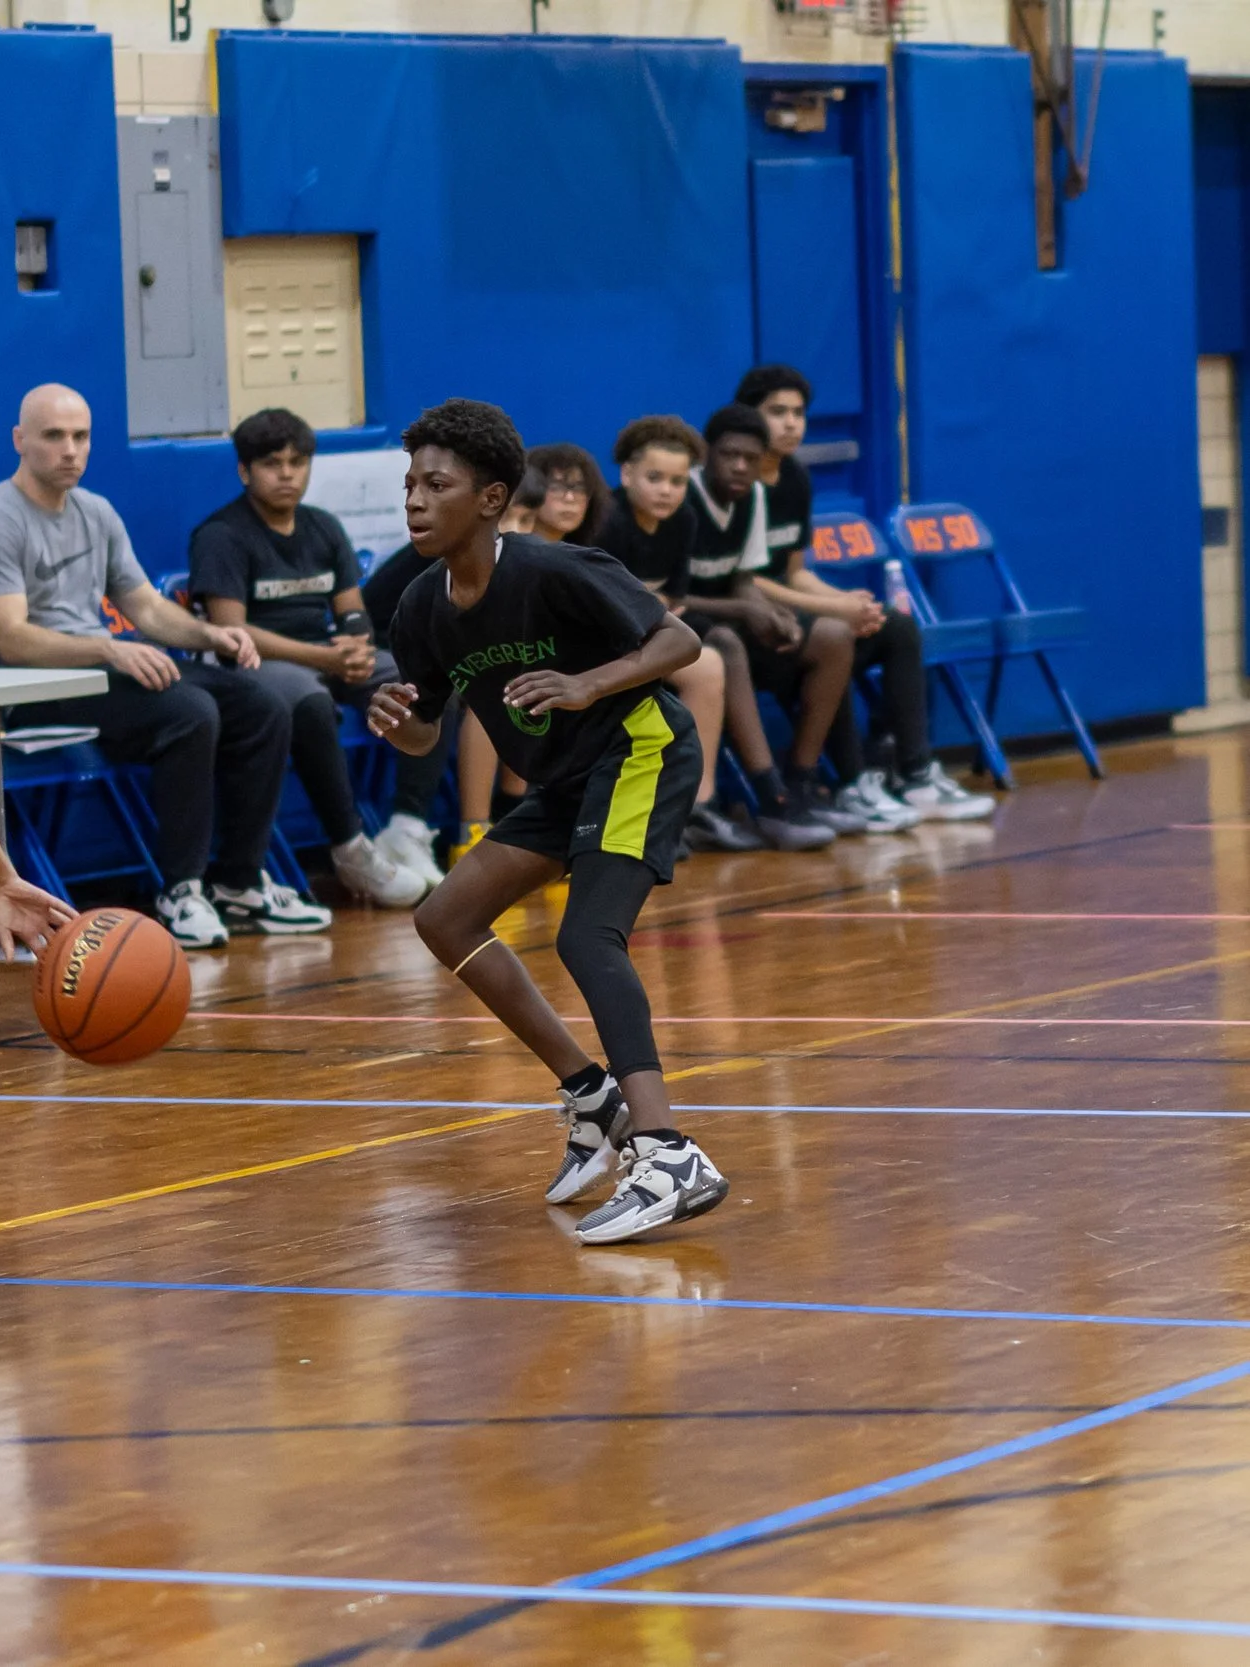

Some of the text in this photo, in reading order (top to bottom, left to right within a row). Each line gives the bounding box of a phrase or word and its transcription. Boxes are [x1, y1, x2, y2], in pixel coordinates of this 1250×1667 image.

[169, 0, 191, 42] B
[839, 521, 875, 558] 50
[942, 514, 979, 549] 50
